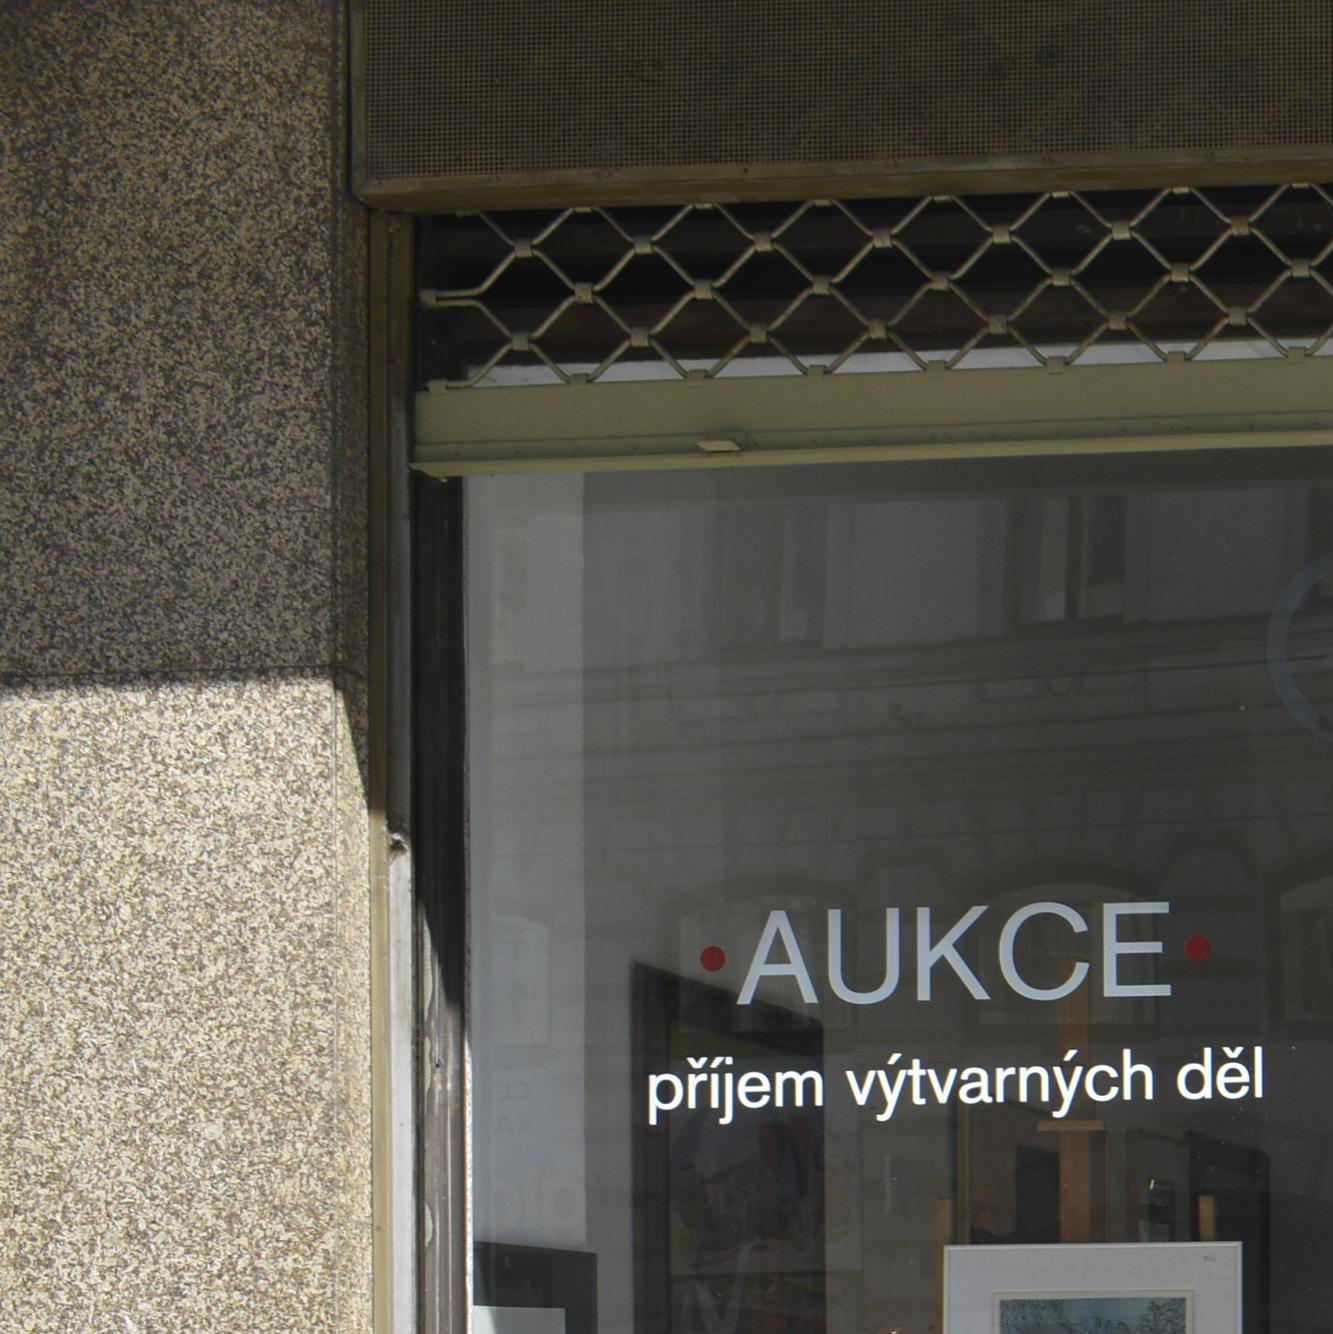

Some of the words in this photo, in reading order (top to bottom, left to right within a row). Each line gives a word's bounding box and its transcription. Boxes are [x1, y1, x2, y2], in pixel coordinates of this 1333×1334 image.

[736, 901, 1172, 1005] AUKCE
[648, 1055, 824, 1125] příjem
[845, 1048, 1154, 1121] výtvarných
[1176, 1046, 1264, 1100] děl
